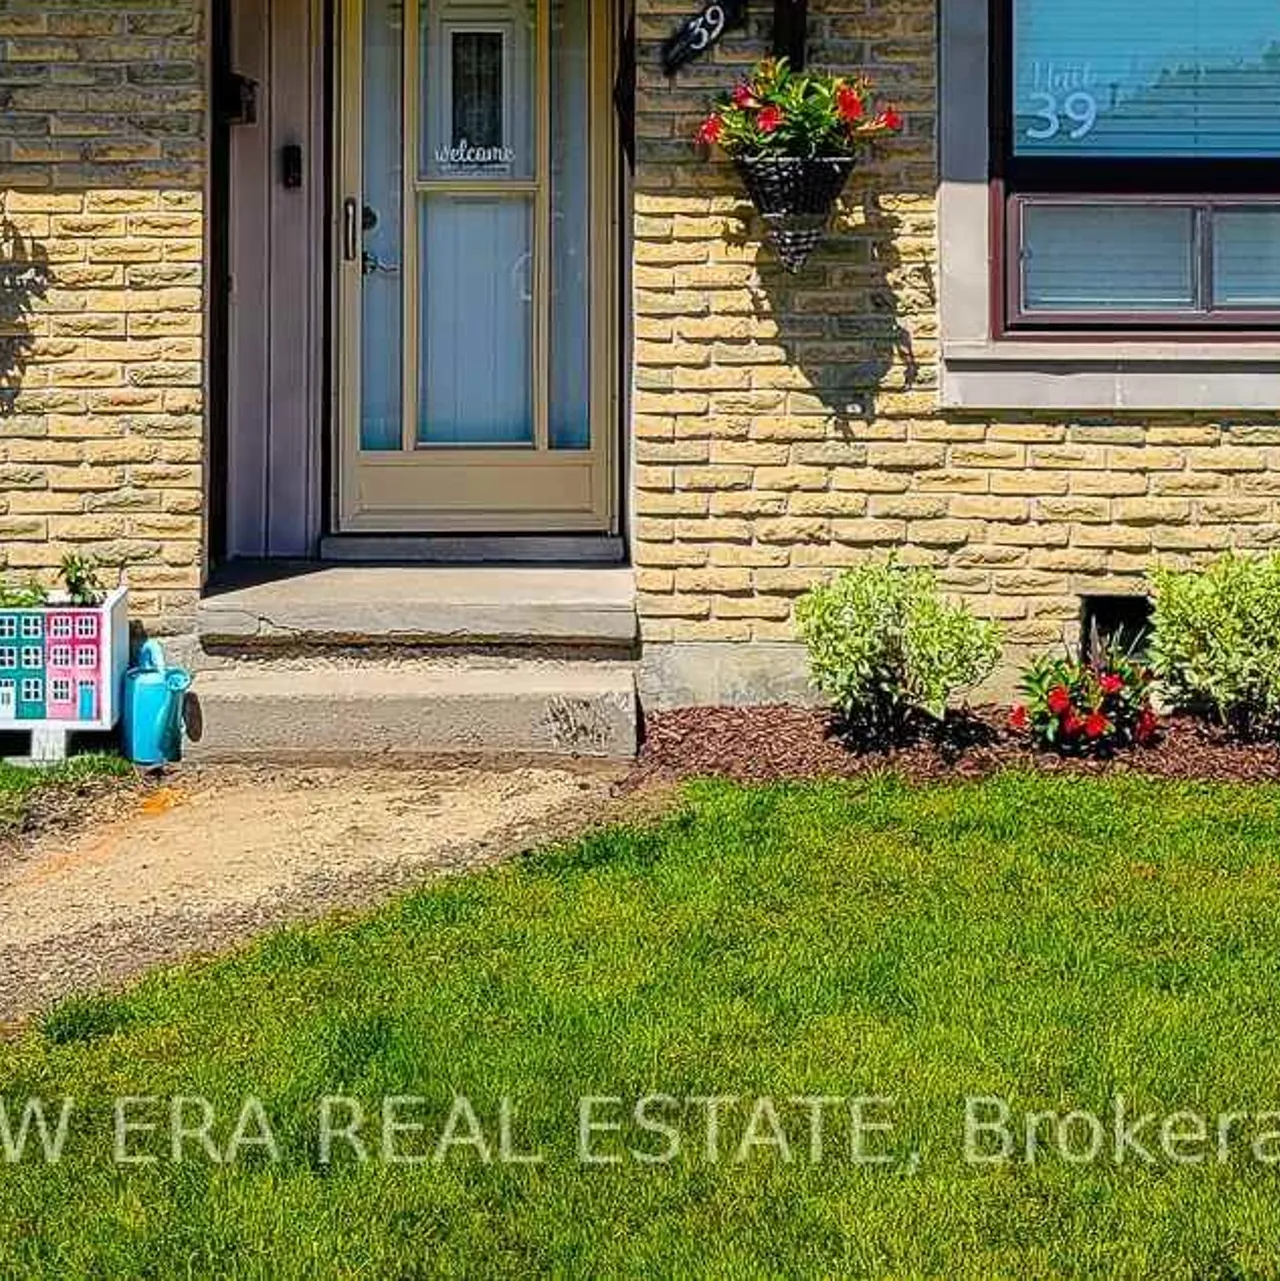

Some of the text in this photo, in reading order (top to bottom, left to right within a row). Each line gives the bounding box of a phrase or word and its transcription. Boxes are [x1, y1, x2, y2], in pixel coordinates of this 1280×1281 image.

[689, 4, 725, 50] 39
[1026, 91, 1097, 139] 39
[433, 138, 516, 163] welcome
